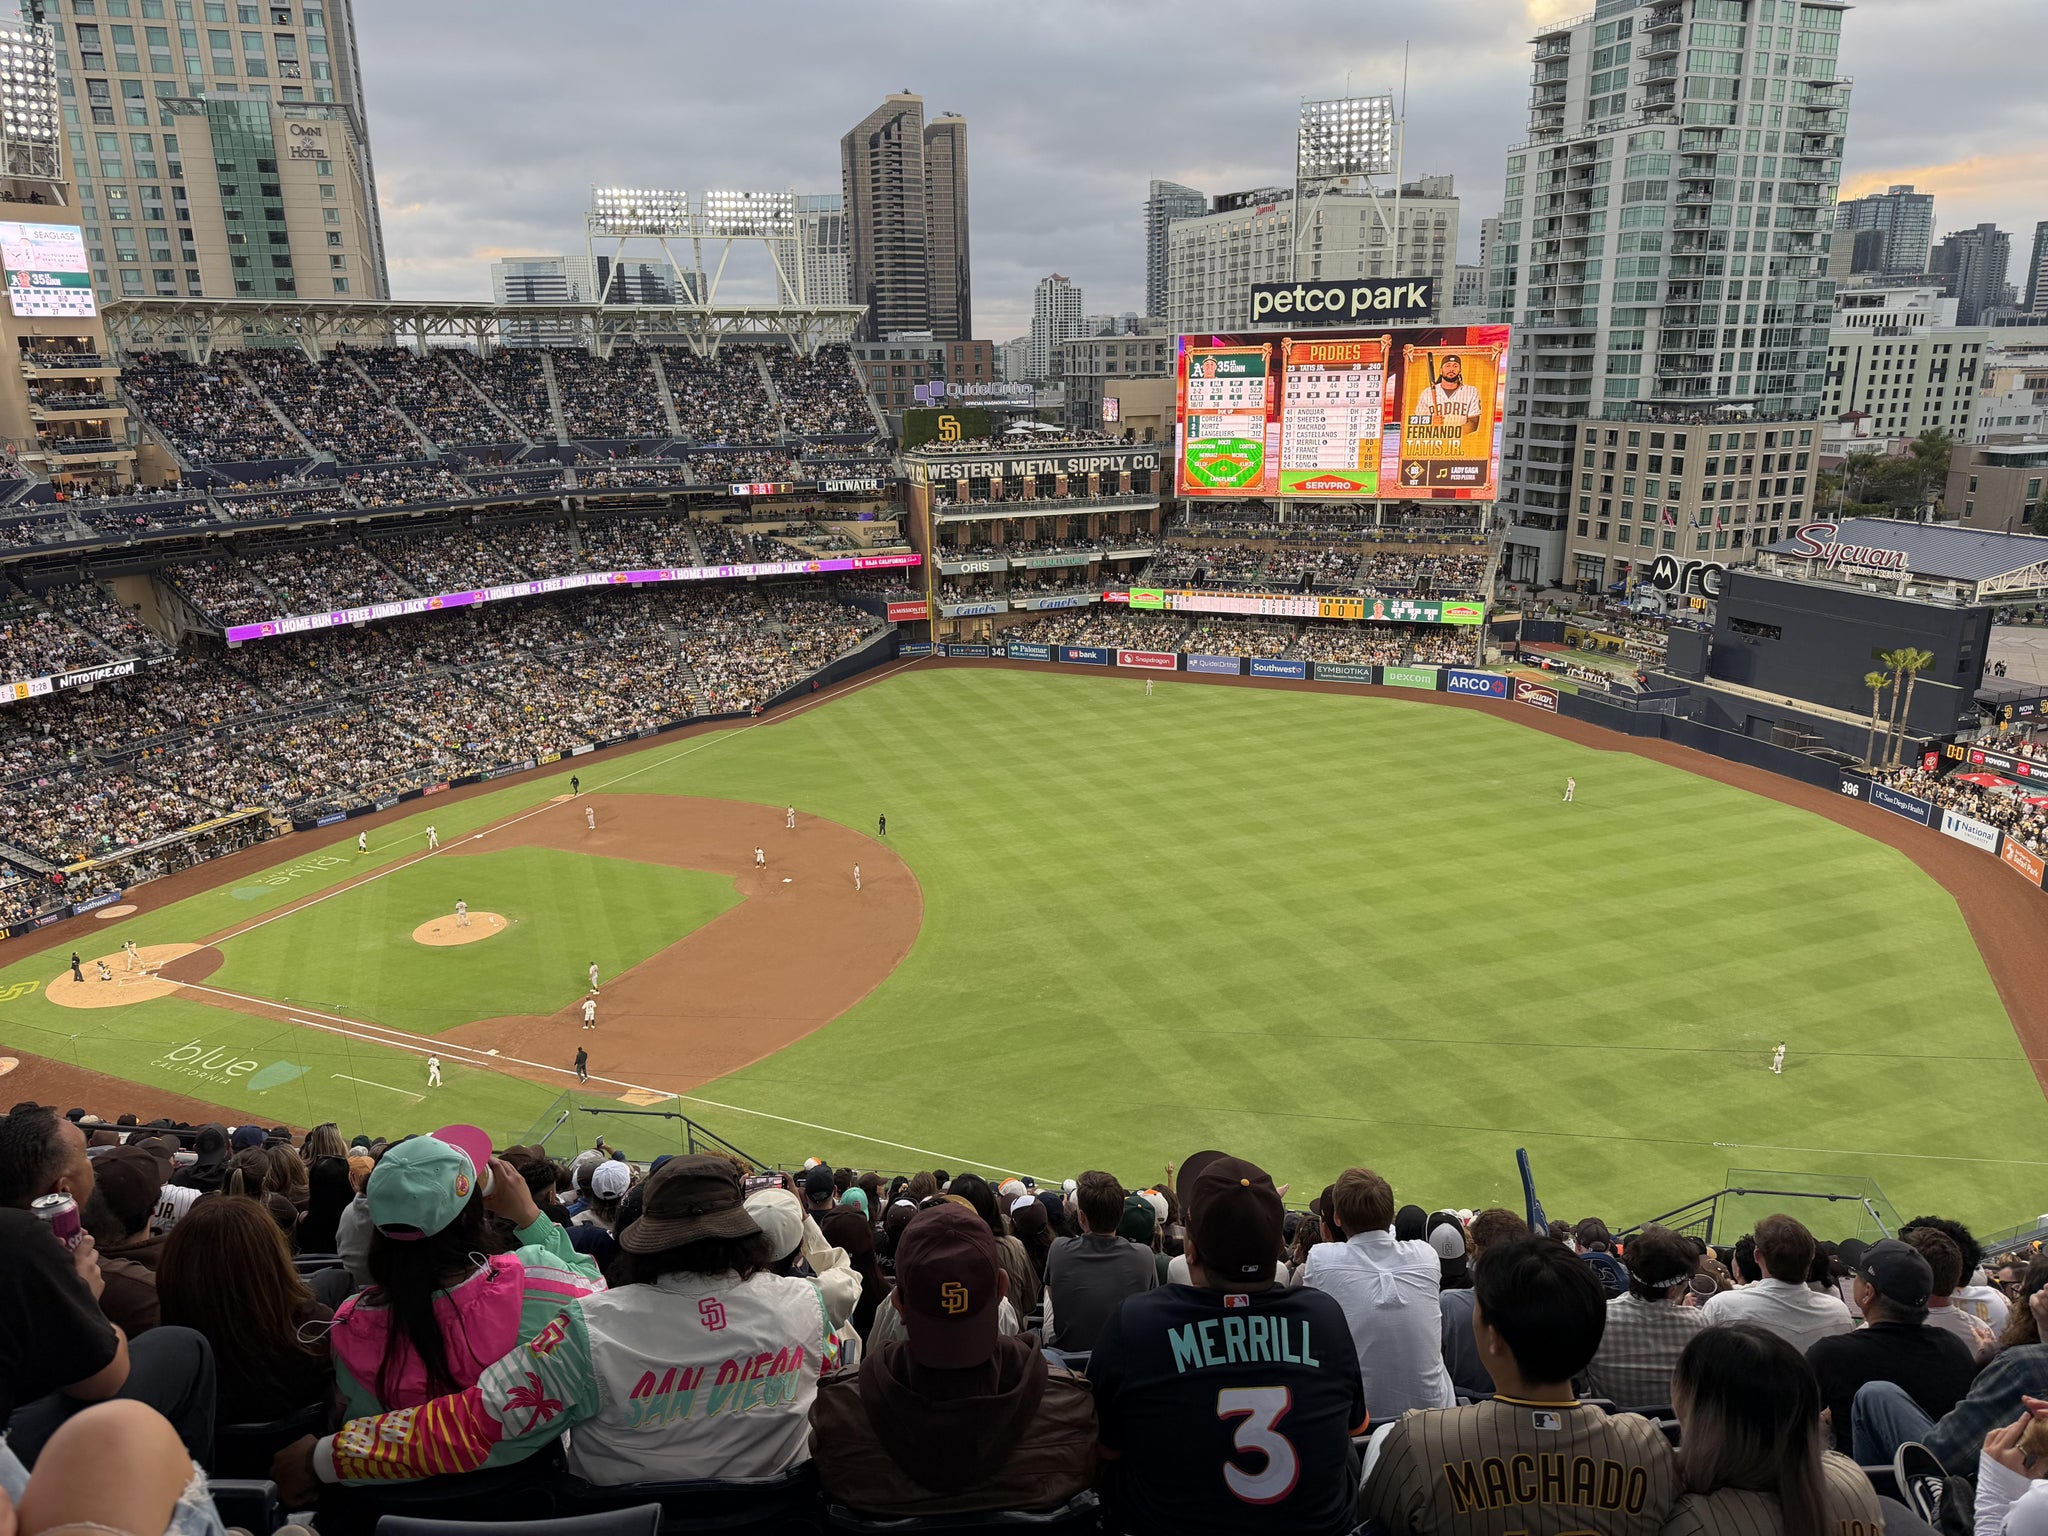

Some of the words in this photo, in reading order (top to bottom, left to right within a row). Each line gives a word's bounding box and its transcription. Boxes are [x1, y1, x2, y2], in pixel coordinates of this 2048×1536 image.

[290, 124, 321, 136] OMNI
[290, 146, 328, 158] HOTEL
[1254, 284, 1345, 320] petco
[1351, 282, 1428, 317] park
[1310, 344, 1360, 360] PADRES
[1217, 361, 1230, 372] 35
[947, 381, 1032, 399] QuidelOrtho
[1407, 426, 1462, 438] FERNANDO
[1406, 440, 1443, 456] TATIS
[1445, 440, 1464, 456] JR.
[927, 462, 1004, 480] WESTERN
[1012, 460, 1063, 476] METAL
[1067, 455, 1127, 473] SUPPLY
[1133, 454, 1158, 470] CO.
[826, 480, 877, 491] CUTWATER
[1792, 523, 1910, 572] Sycuan
[671, 571, 676, 579] 1
[677, 569, 702, 580] HOME
[703, 568, 719, 577] RUN
[735, 566, 753, 576] FREE
[755, 564, 779, 575] JUMBO
[961, 563, 990, 573] ORIS
[490, 588, 514, 598] HOME
[514, 585, 530, 595] RUN
[543, 581, 561, 591] FREE
[562, 578, 587, 589] JUMBO
[281, 618, 310, 632] HOME
[312, 616, 332, 628] RUN
[349, 610, 370, 622] FREE
[371, 605, 401, 619] JUMBO
[1324, 605, 1330, 615] 0
[1338, 606, 1344, 616] 0
[1354, 606, 1357, 617] 1
[992, 648, 1005, 656] 342
[1020, 646, 1047, 654] Palomar
[1135, 656, 1170, 664] Snapdragon
[60, 662, 134, 688] NITTOTIRE.COM
[1254, 664, 1296, 674] Southwest
[1317, 666, 1369, 675] CYMBIOTIKA
[19, 686, 24, 694] 2
[32, 683, 47, 692] 7:28
[1450, 676, 1490, 691] ARCO
[1518, 683, 1553, 704] Sycuan
[1984, 757, 2010, 768] TOYOTA
[1841, 781, 1859, 797] 396
[1876, 791, 1884, 799] UC
[1908, 803, 1924, 815] Health
[1962, 822, 1994, 840] National
[78, 896, 112, 913] Southwest
[163, 1038, 258, 1076] blue
[150, 1060, 232, 1085] CALIFORNIA
[155, 1202, 175, 1219] JR.
[941, 1282, 968, 1314] SD
[698, 1297, 727, 1331] SD
[1168, 1315, 1319, 1374] MERRILL
[624, 1367, 704, 1428] SAN
[706, 1344, 804, 1417] DIEGO
[1217, 1385, 1300, 1505] 3
[1442, 1454, 1648, 1515] MACHADO
